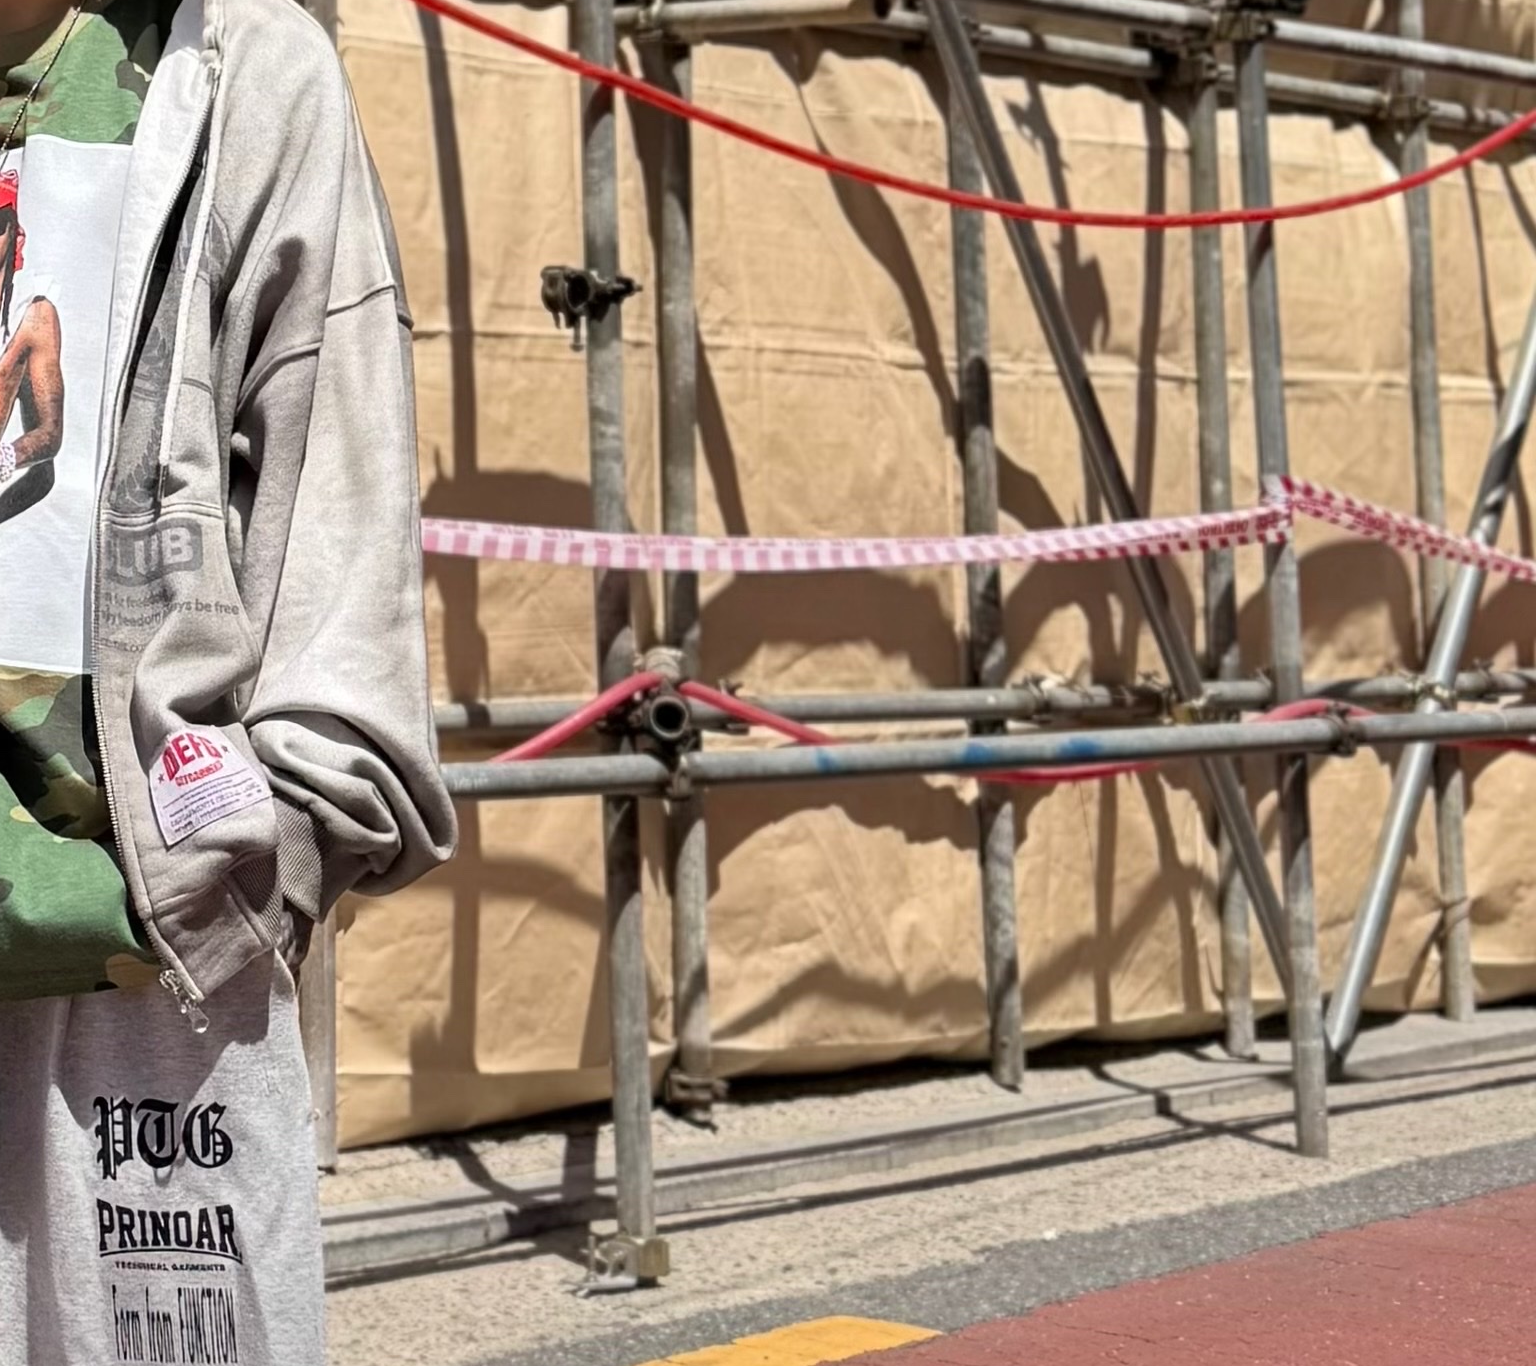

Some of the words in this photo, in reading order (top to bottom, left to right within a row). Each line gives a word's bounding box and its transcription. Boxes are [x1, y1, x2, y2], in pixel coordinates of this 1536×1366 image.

[195, 598, 212, 613] be
[214, 601, 239, 616] free
[96, 1198, 239, 1257] PRINOAR
